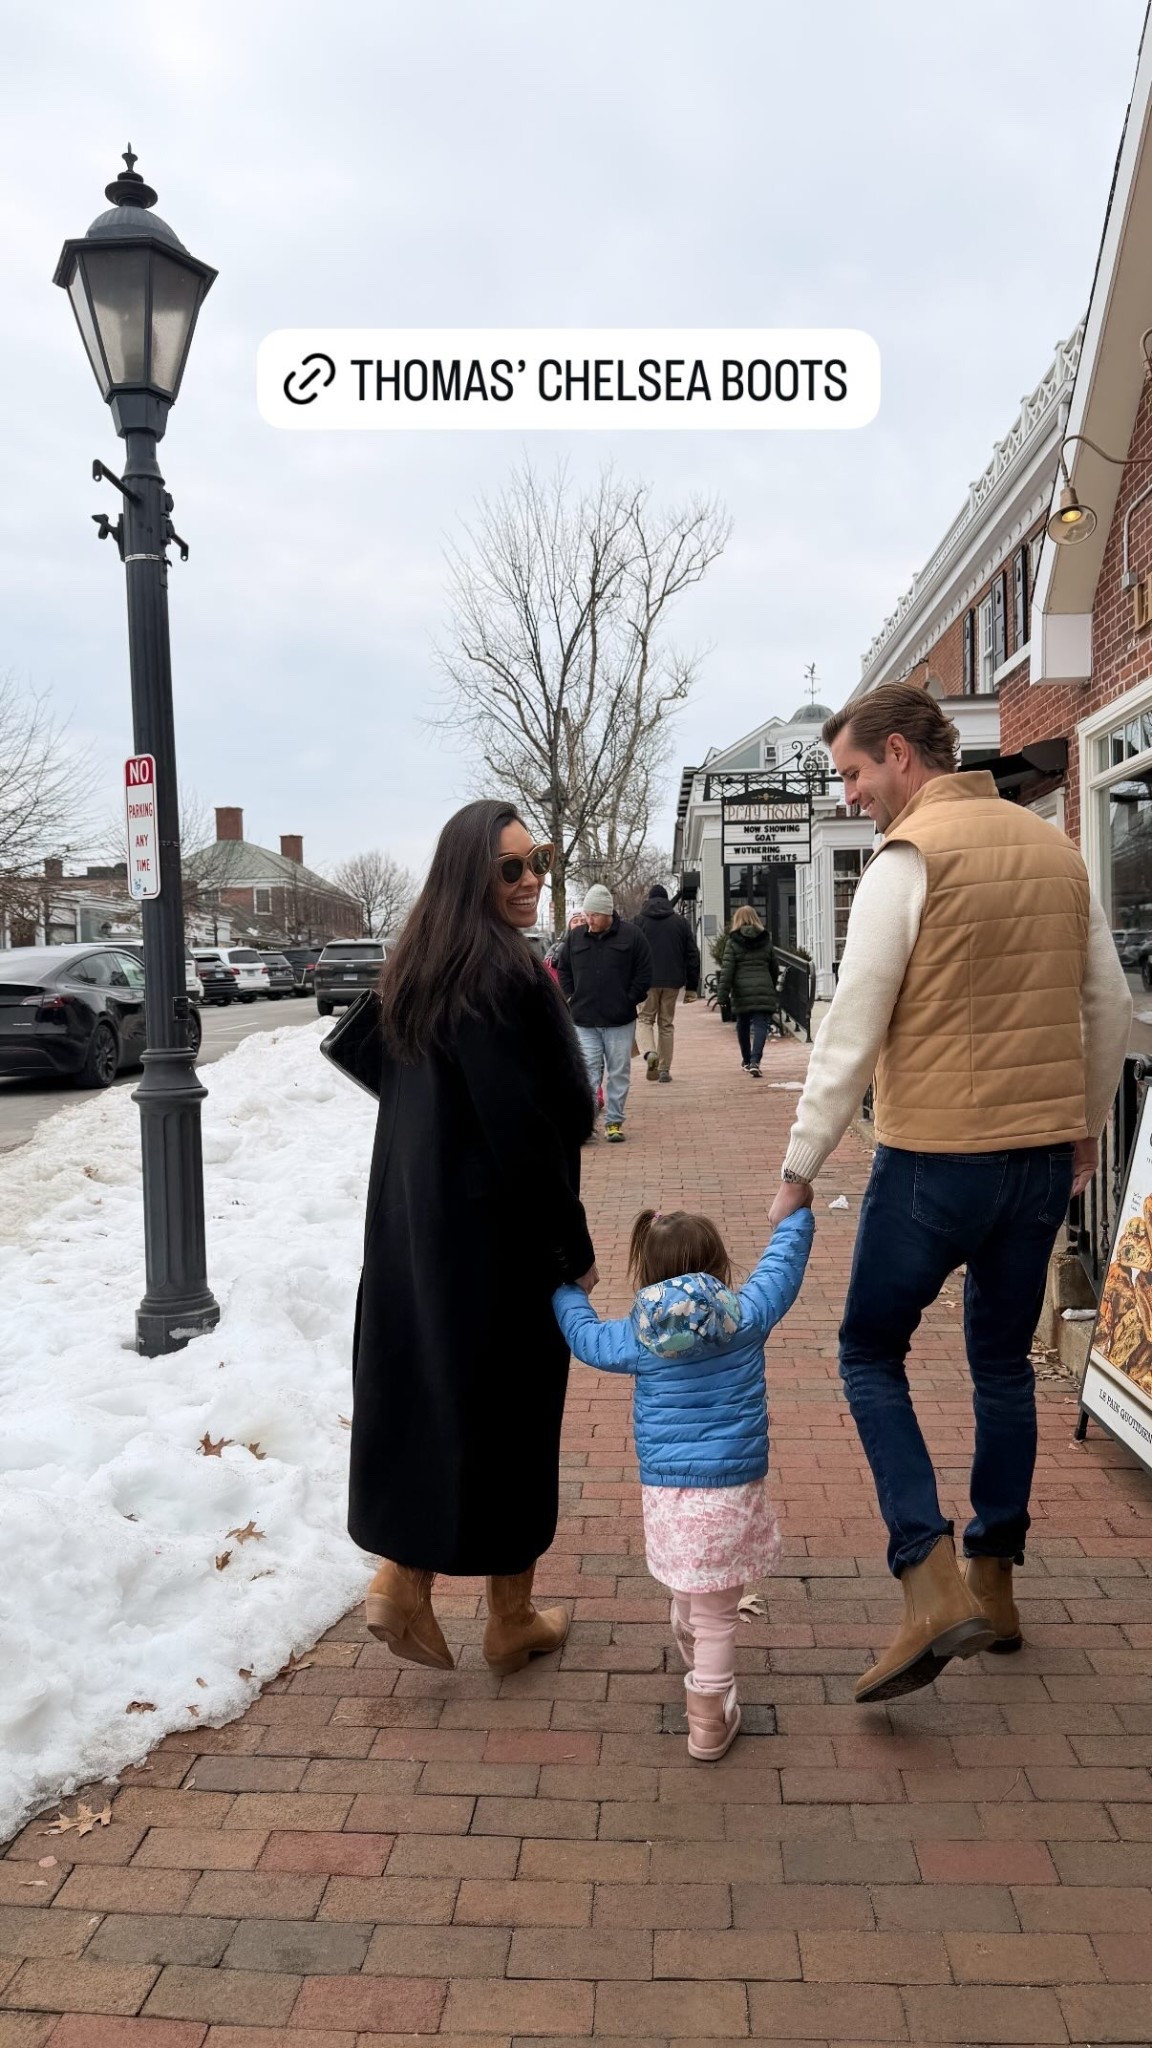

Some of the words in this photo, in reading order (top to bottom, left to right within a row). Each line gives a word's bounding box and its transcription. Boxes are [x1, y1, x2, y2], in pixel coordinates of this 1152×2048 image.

[129, 760, 150, 784] NO
[128, 802, 153, 819] PARKING
[764, 825, 800, 833] SHOWING
[135, 834, 149, 848] ANY
[755, 834, 776, 842] GOAT
[734, 846, 780, 854] WUTHERING
[761, 854, 797, 862] HEIGHTS
[136, 859, 151, 872] TIME
[1099, 1388, 1107, 1402] LE
